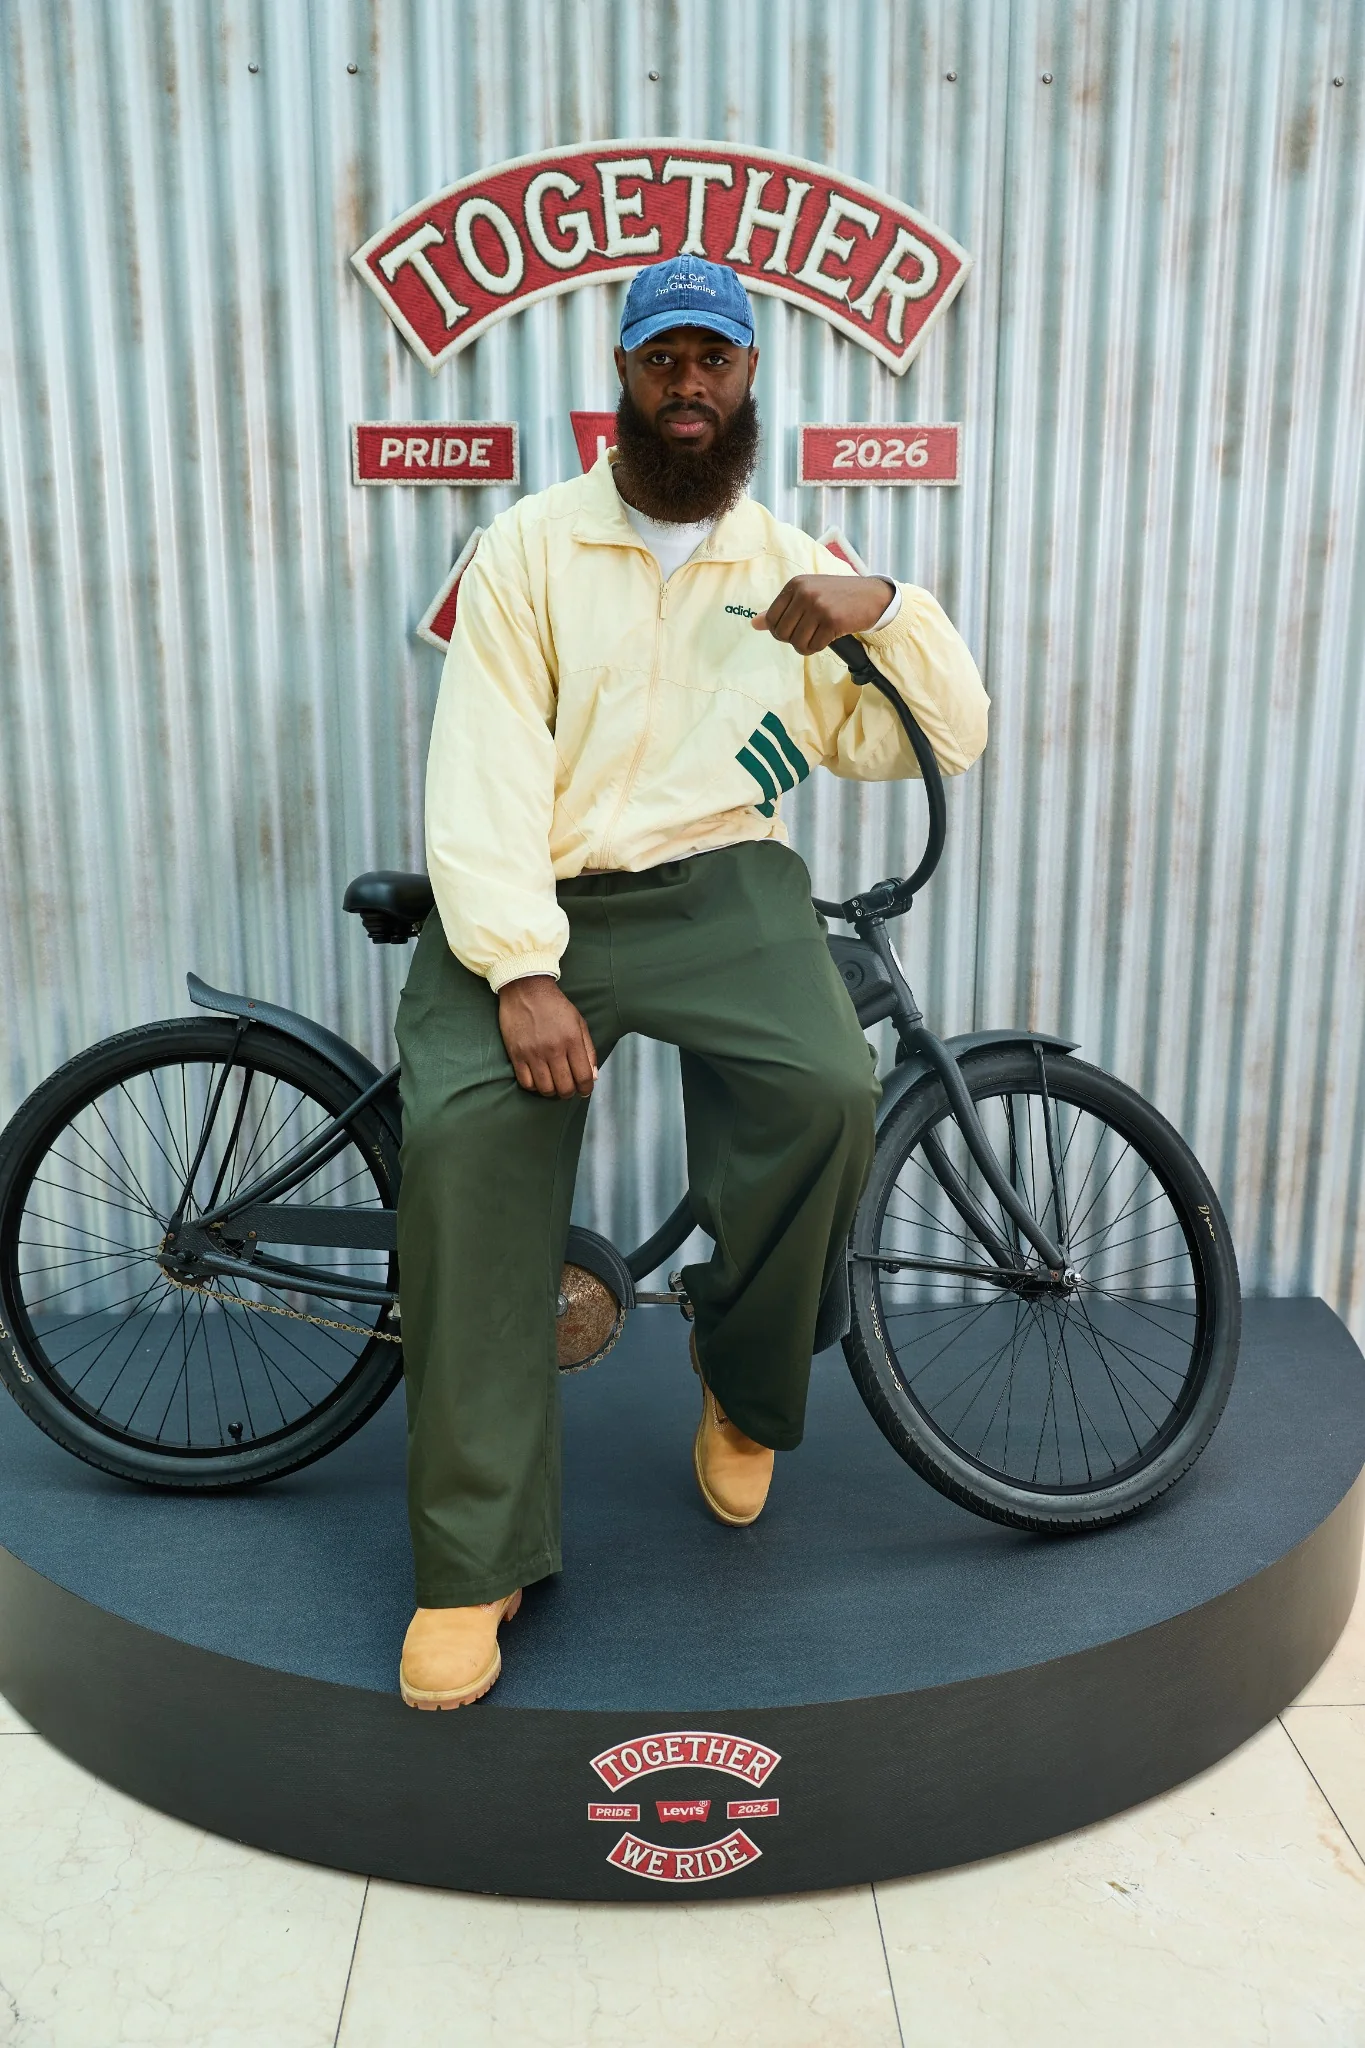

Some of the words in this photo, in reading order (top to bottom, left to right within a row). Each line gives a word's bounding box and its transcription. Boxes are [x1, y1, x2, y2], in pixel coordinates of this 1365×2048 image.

[379, 156, 940, 345] TOGETHER
[689, 273, 705, 282] Off
[655, 289, 668, 297] I'm
[670, 282, 716, 296] Gardening
[380, 438, 493, 467] PRIDE
[833, 439, 928, 468] 2026
[725, 605, 757, 618] adida
[597, 1736, 771, 1781] TOGETHER
[596, 1808, 632, 1817] PRIDE
[738, 1804, 769, 1814] 2026
[621, 1839, 668, 1875] WE
[674, 1838, 748, 1878] RIDE
